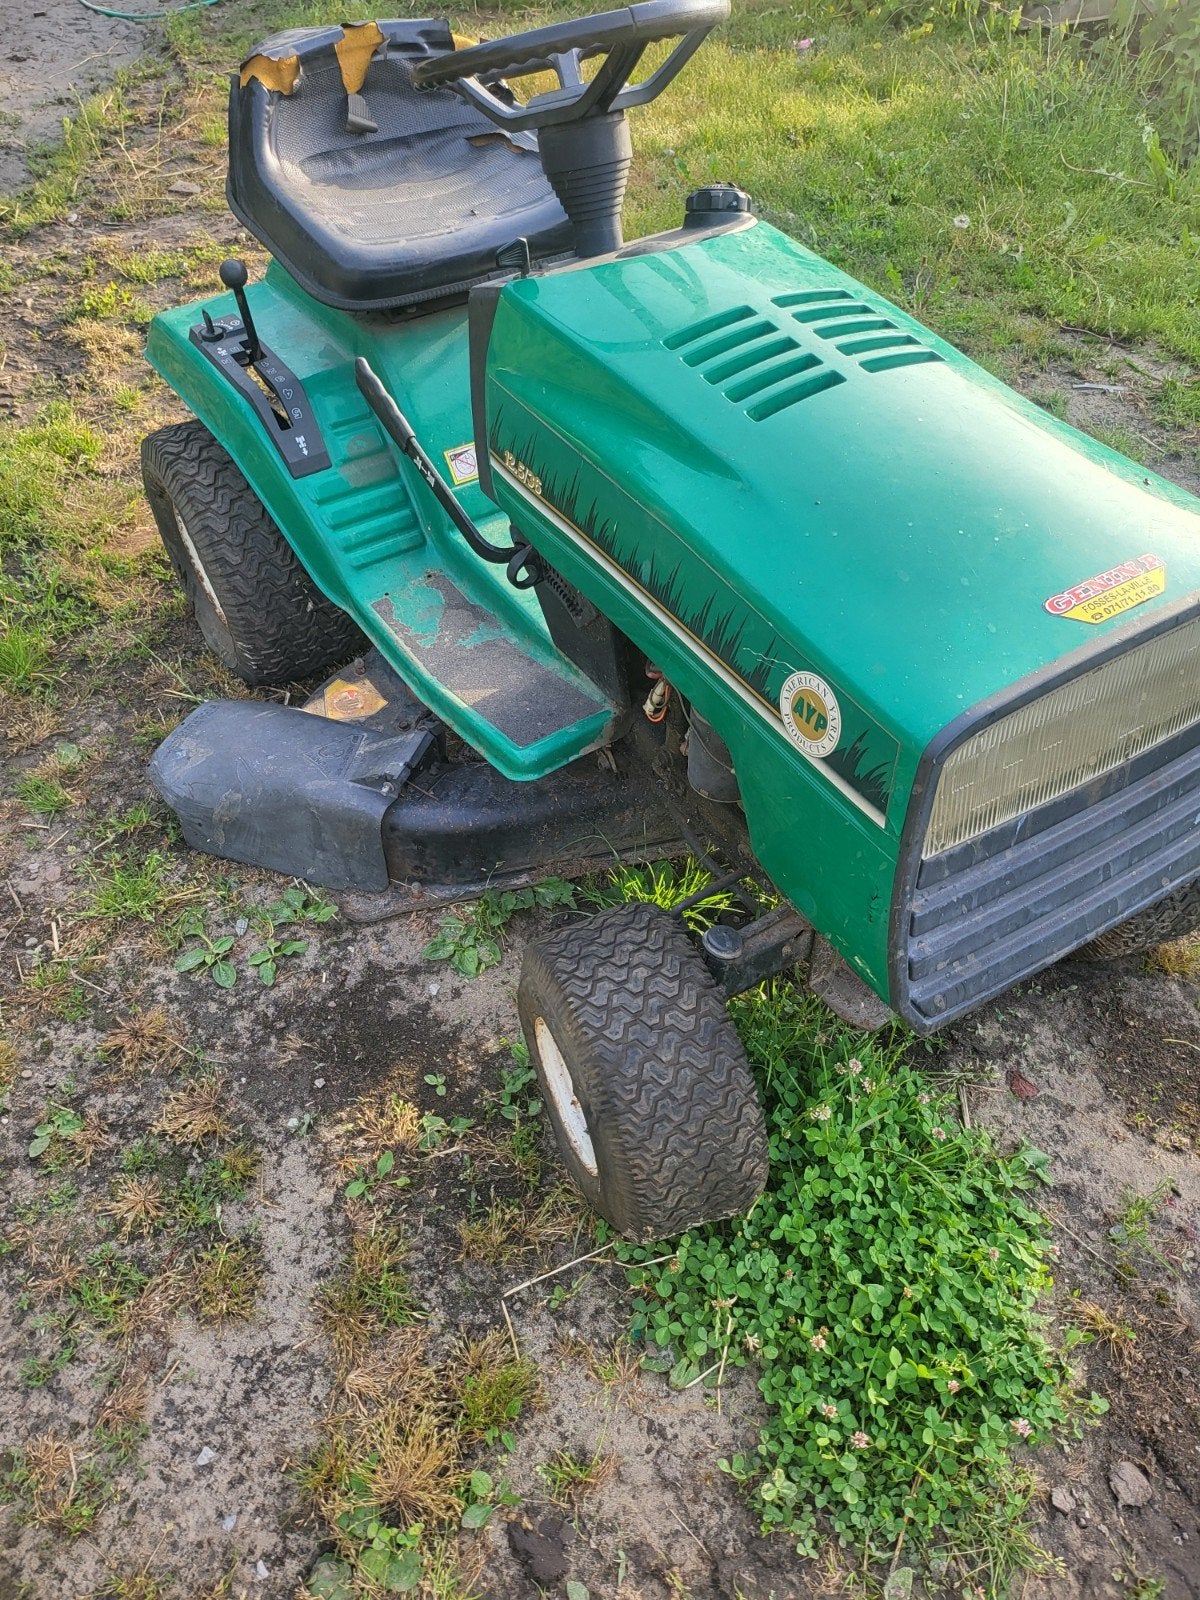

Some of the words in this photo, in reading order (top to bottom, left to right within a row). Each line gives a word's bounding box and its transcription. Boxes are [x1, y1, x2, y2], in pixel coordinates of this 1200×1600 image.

[504, 450, 542, 495] 12.5/36
[1045, 560, 1143, 614] GENIN
[1137, 553, 1160, 570] P
[1082, 576, 1153, 613] FOSSES-LA-VILLE
[1104, 584, 1160, 615] 071/71.11.80
[784, 676, 829, 703] AMERICAN
[827, 706, 838, 742] YARD
[792, 696, 828, 732] AYP
[784, 713, 827, 753] PRODUCTS
